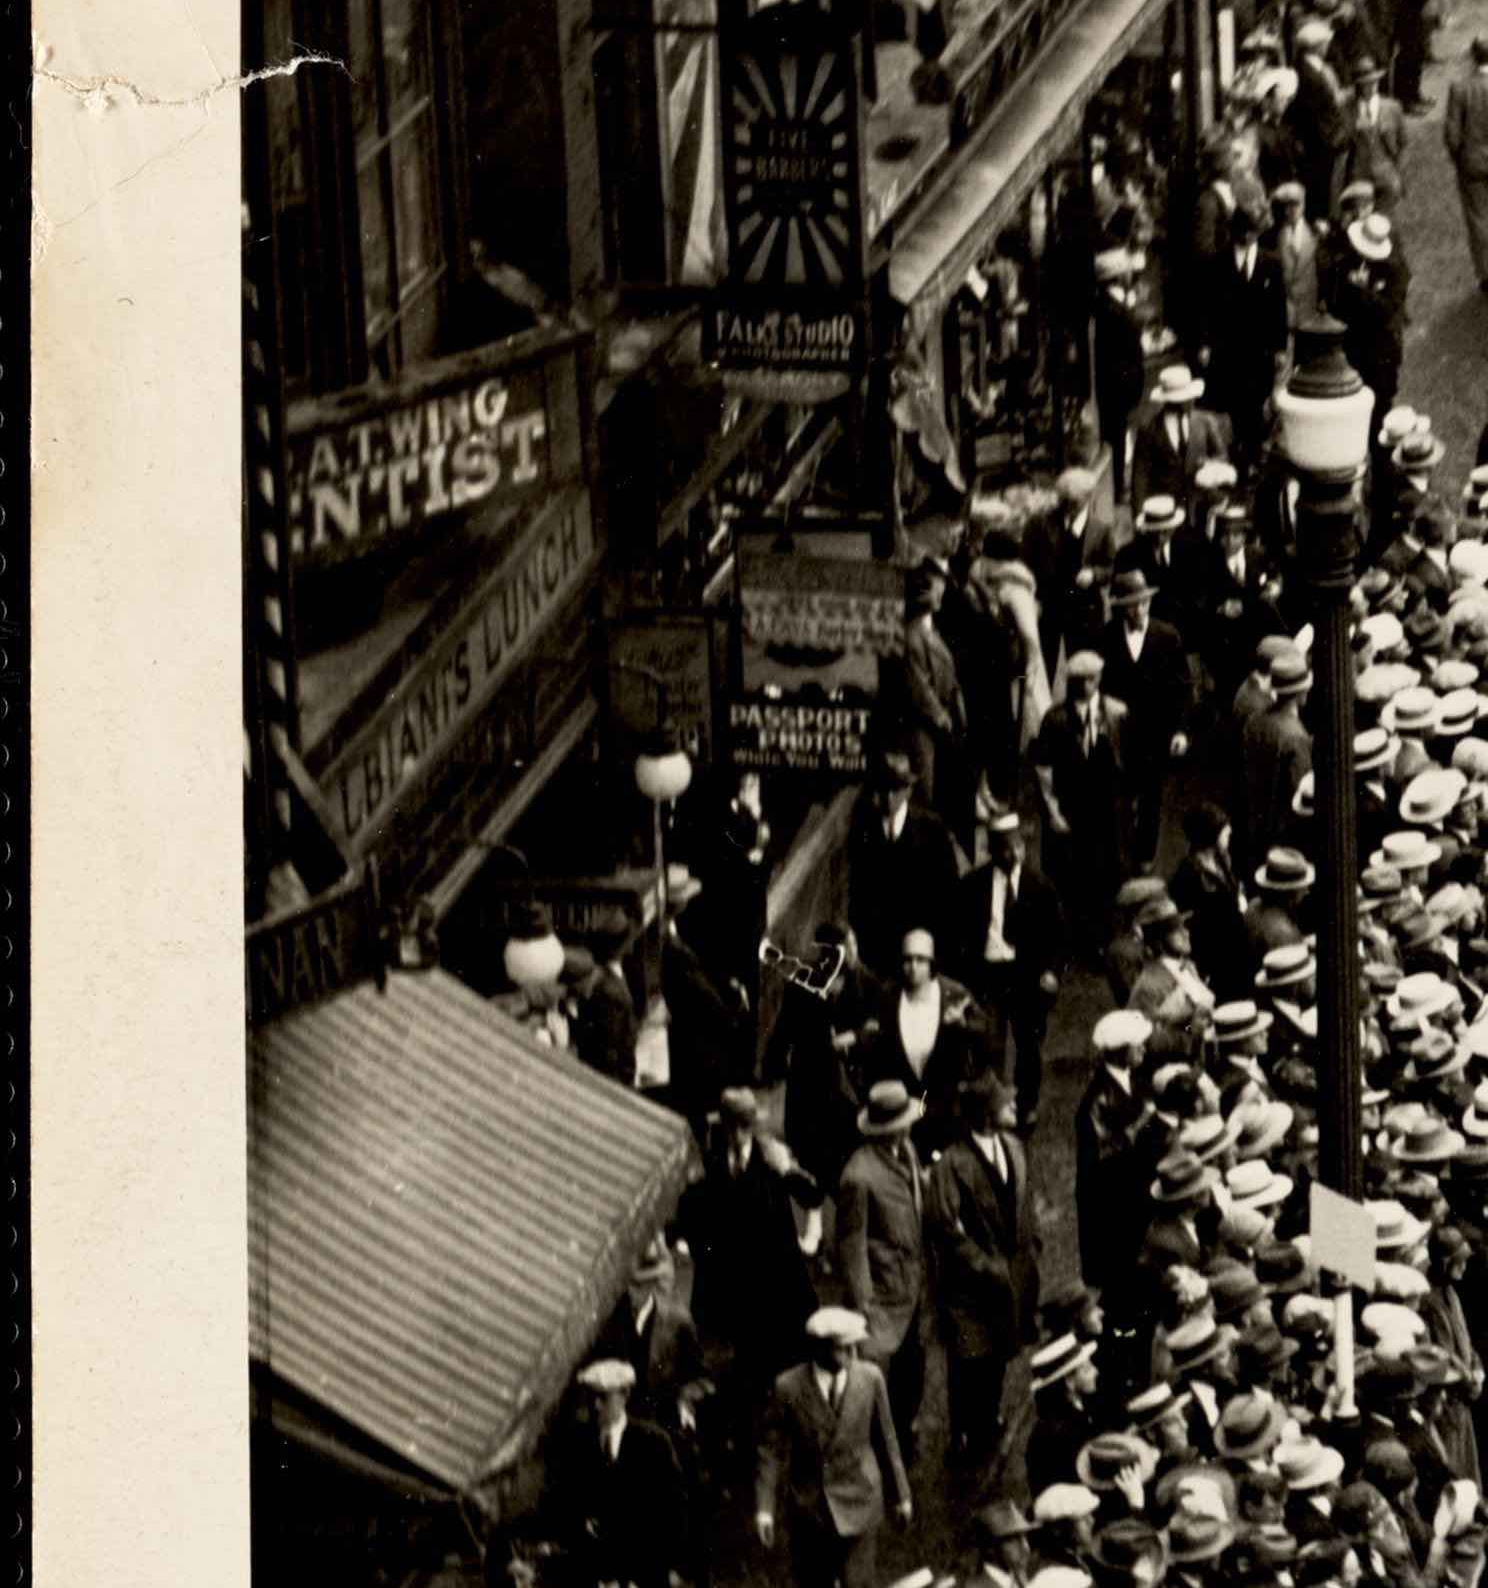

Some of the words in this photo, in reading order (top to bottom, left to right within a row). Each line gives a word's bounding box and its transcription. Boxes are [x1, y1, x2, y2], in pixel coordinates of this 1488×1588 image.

[784, 310, 855, 349] STUDIO
[480, 517, 585, 680] LUNCH
[730, 703, 870, 735] PASSPORT
[758, 728, 862, 755] PHOTOS
[784, 751, 820, 770] You
[828, 753, 868, 771] Wait
